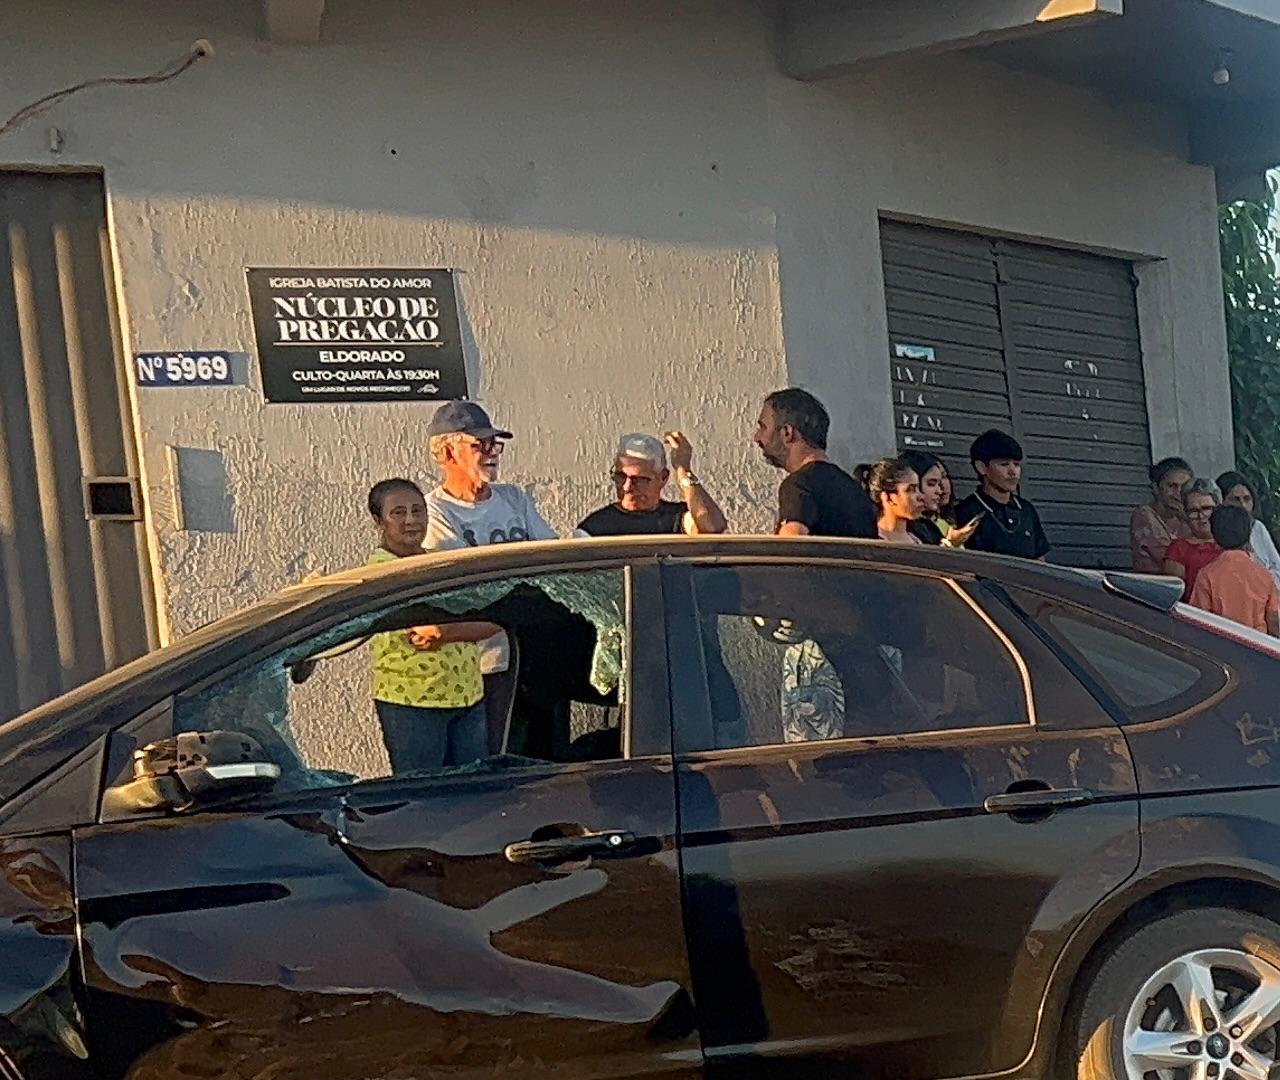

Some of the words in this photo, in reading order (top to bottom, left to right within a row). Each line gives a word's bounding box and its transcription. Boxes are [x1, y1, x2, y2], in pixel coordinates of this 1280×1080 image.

[269, 277, 315, 289] IGREJA
[317, 277, 370, 289] BATISTA
[370, 278, 391, 288] DO
[393, 277, 432, 289] AMOR
[272, 293, 396, 319] NÚCLEO
[398, 297, 440, 318] DE
[278, 315, 440, 343] PREGAÇÃO
[319, 350, 406, 363] ELDORADO
[166, 356, 228, 381] 5969
[292, 370, 386, 382] CULTO-QUARTA
